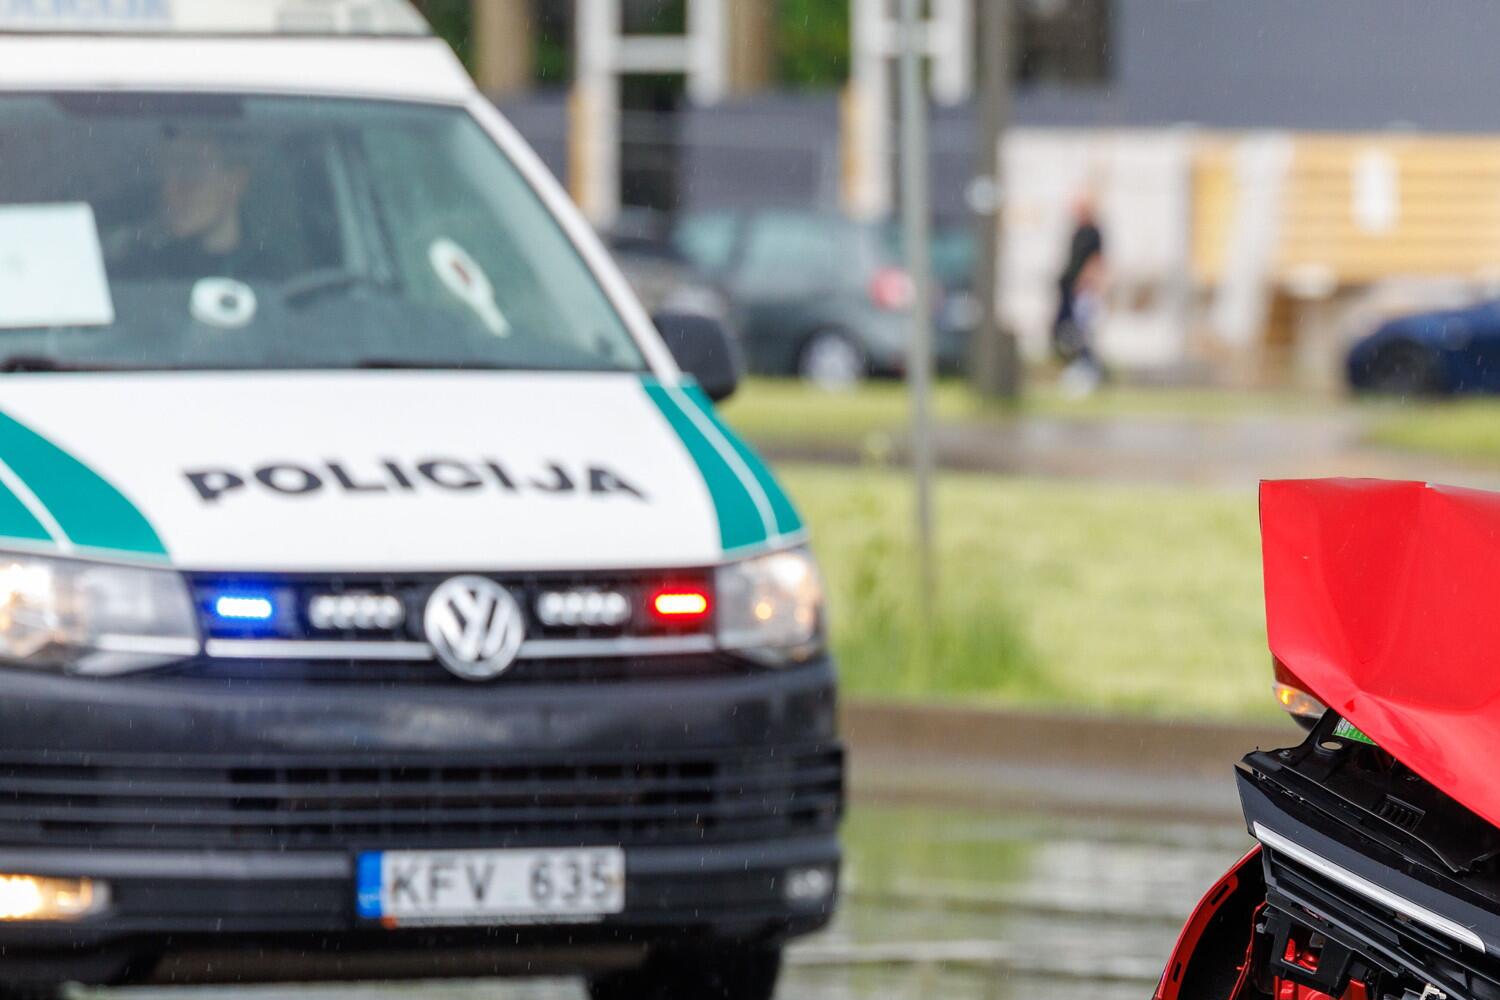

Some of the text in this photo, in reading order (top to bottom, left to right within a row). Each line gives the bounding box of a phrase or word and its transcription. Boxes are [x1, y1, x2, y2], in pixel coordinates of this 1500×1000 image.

[183, 459, 647, 502] POLICIJA
[391, 858, 610, 904] KFV 635
